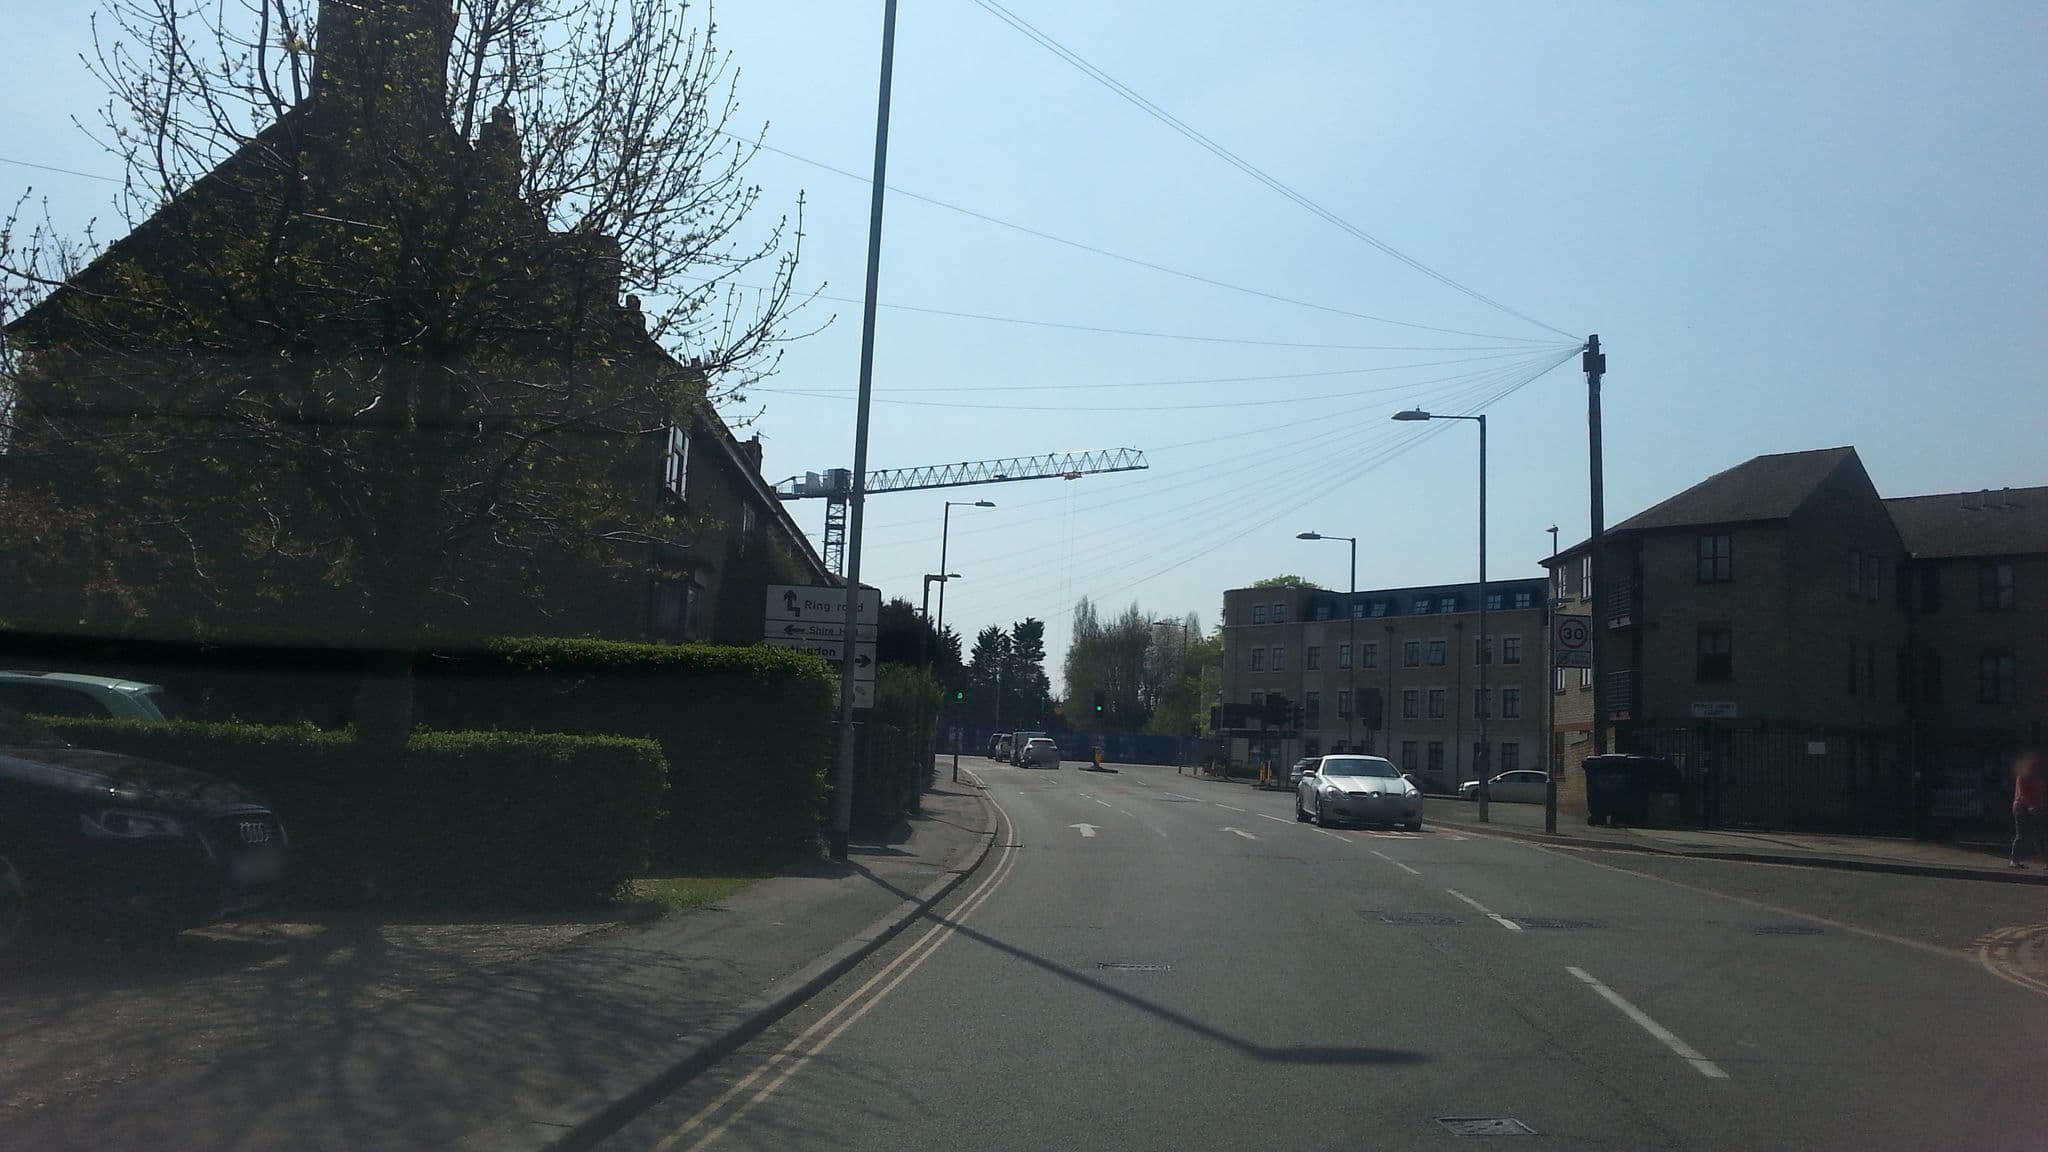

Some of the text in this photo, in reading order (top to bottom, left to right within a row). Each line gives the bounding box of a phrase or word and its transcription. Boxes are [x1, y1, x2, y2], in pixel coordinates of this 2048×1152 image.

[804, 600, 863, 613] Ring rod
[809, 626, 834, 636] Shire
[1563, 627, 1584, 640] 30
